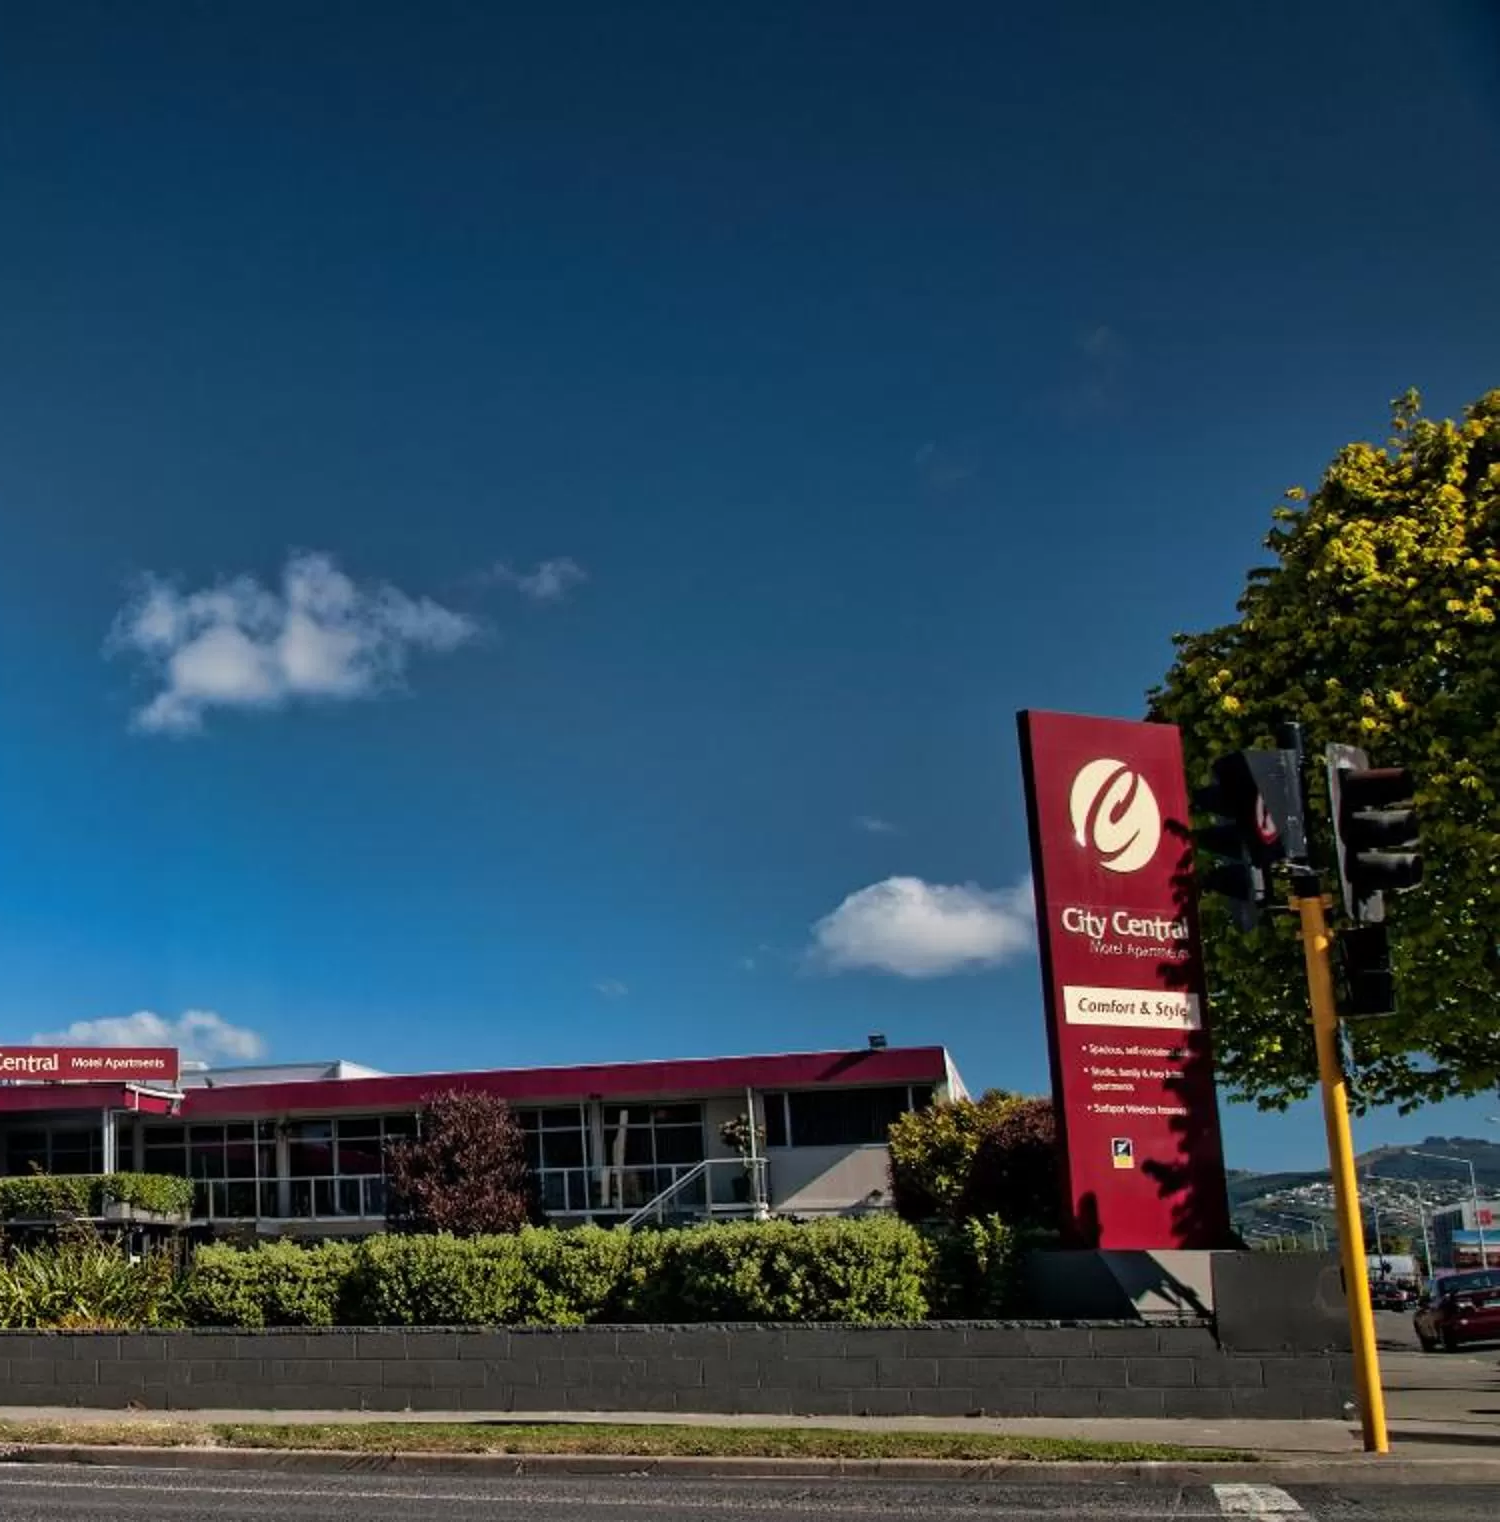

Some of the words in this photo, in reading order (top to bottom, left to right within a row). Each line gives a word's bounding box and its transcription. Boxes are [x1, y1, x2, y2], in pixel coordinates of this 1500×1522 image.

[1061, 907, 1108, 939] City
[1111, 911, 1189, 942] Central
[1077, 997, 1136, 1015] Comfort
[1139, 1001, 1151, 1016] &
[1155, 1001, 1188, 1021] Style
[71, 1057, 102, 1069] Motel
[105, 1057, 165, 1070] Apartments
